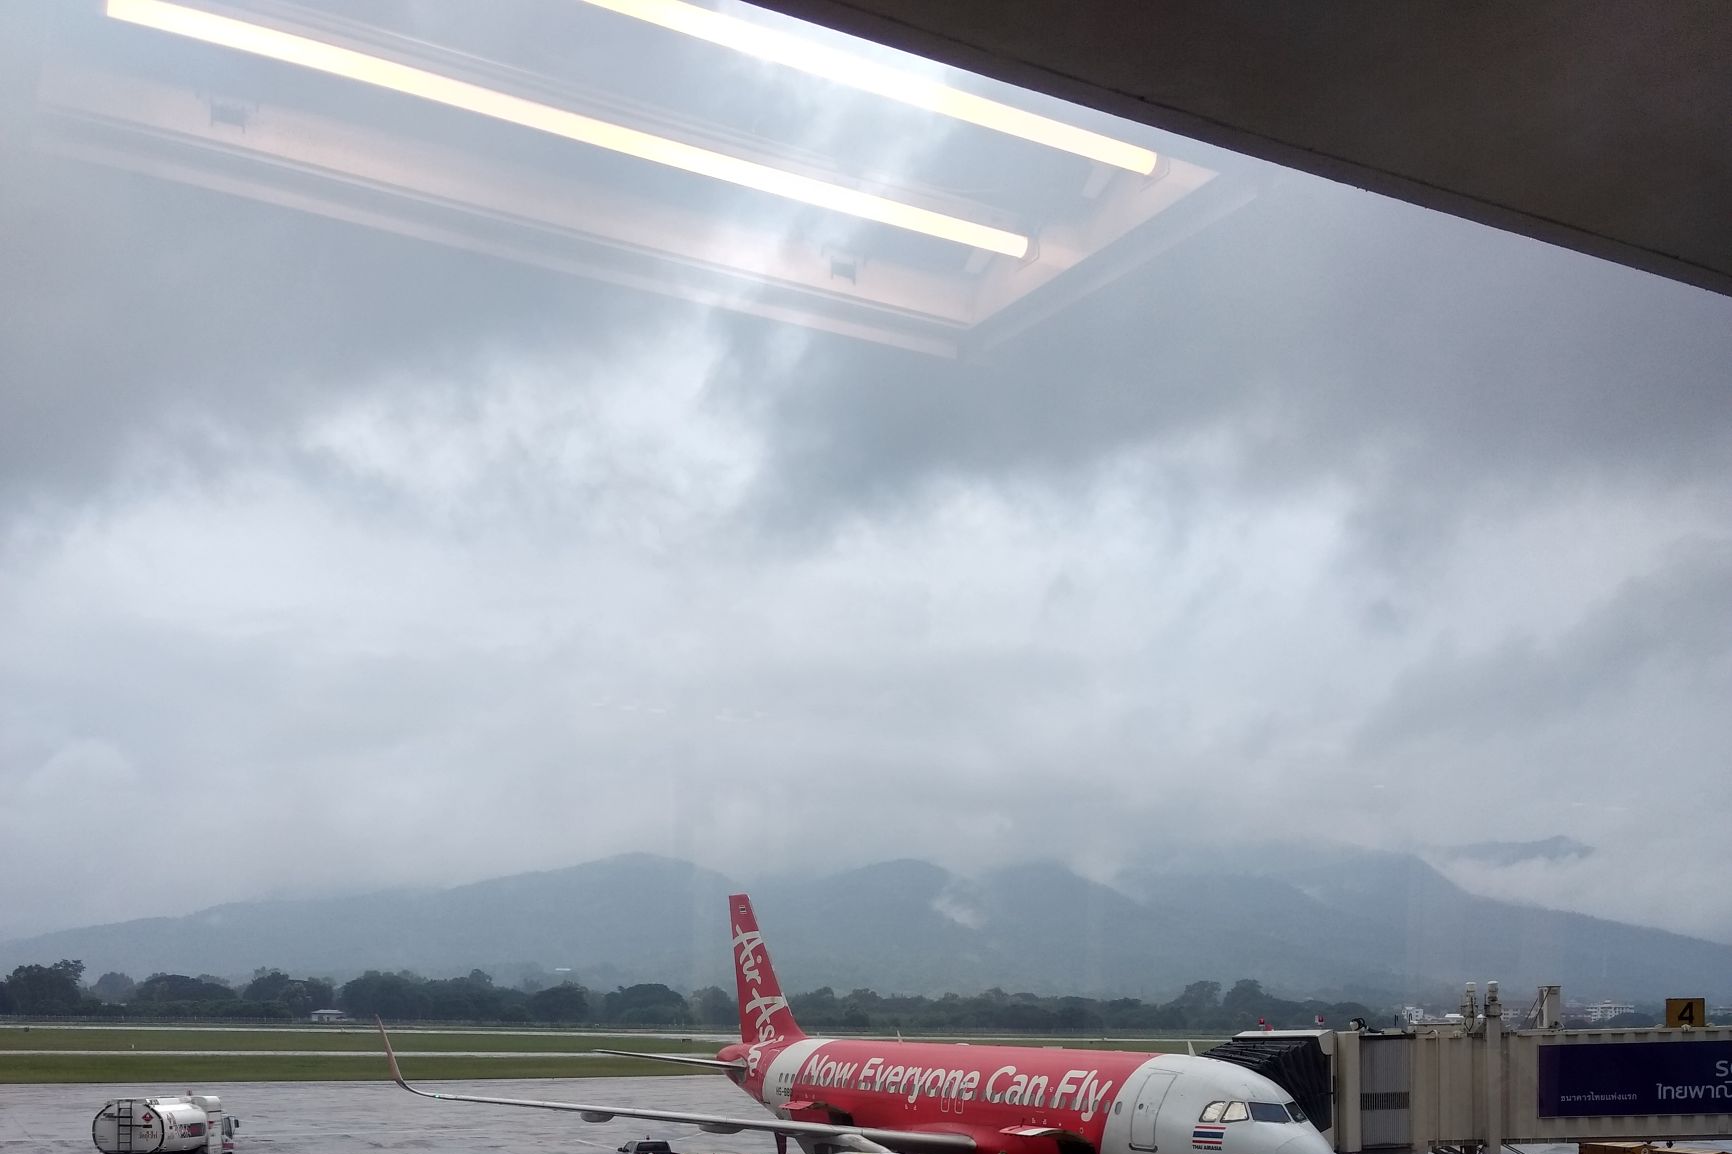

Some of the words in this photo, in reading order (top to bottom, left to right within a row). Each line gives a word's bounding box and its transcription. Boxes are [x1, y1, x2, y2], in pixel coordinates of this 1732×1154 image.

[1677, 1001, 1695, 1024] 4
[1715, 1060, 1732, 1078] S
[802, 1054, 858, 1089] Now
[858, 1057, 981, 1104] Everyone
[986, 1065, 1049, 1108] Can
[1053, 1069, 1113, 1122] Fly
